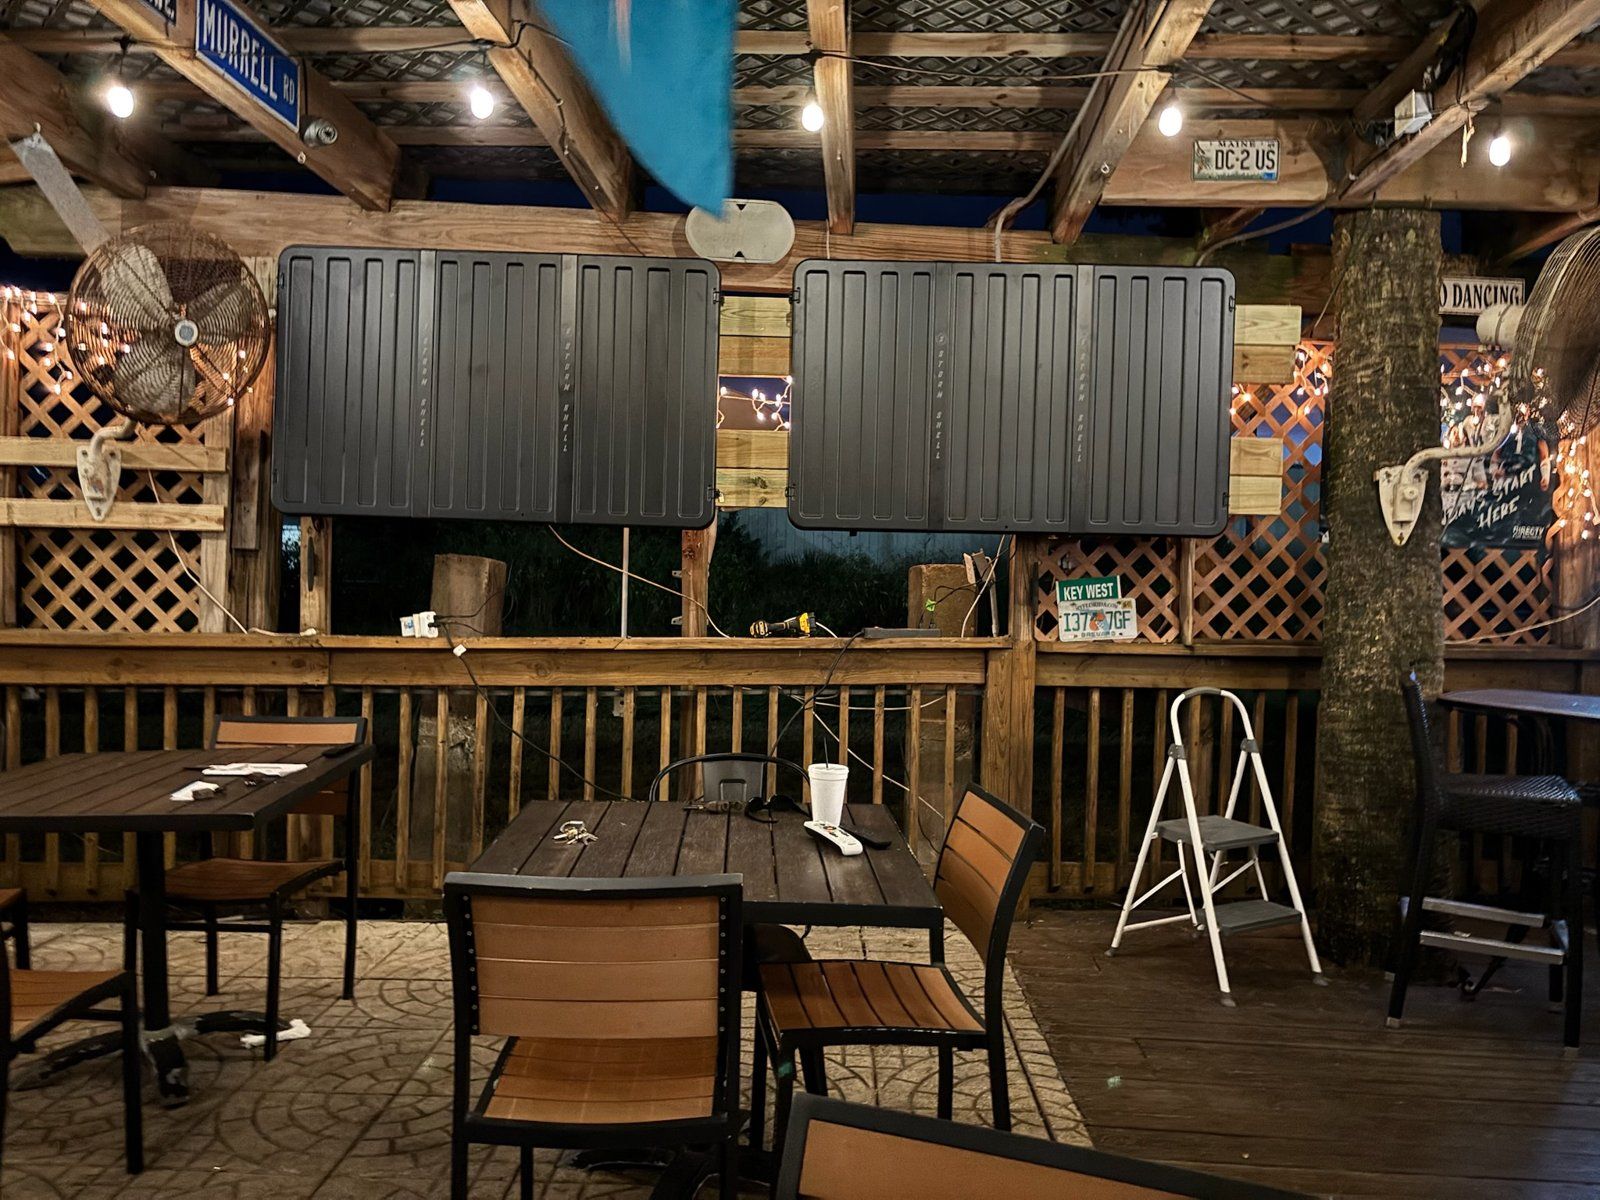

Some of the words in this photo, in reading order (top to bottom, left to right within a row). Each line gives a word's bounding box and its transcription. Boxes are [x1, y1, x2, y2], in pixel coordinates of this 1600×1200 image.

[202, 1, 278, 102] MURRELL
[283, 73, 295, 105] RD
[1256, 149, 1275, 170] US
[1453, 284, 1519, 309] DANCING
[1063, 585, 1083, 601] KEY
[1085, 582, 1114, 599] WEST
[1105, 610, 1131, 630] 7GF
